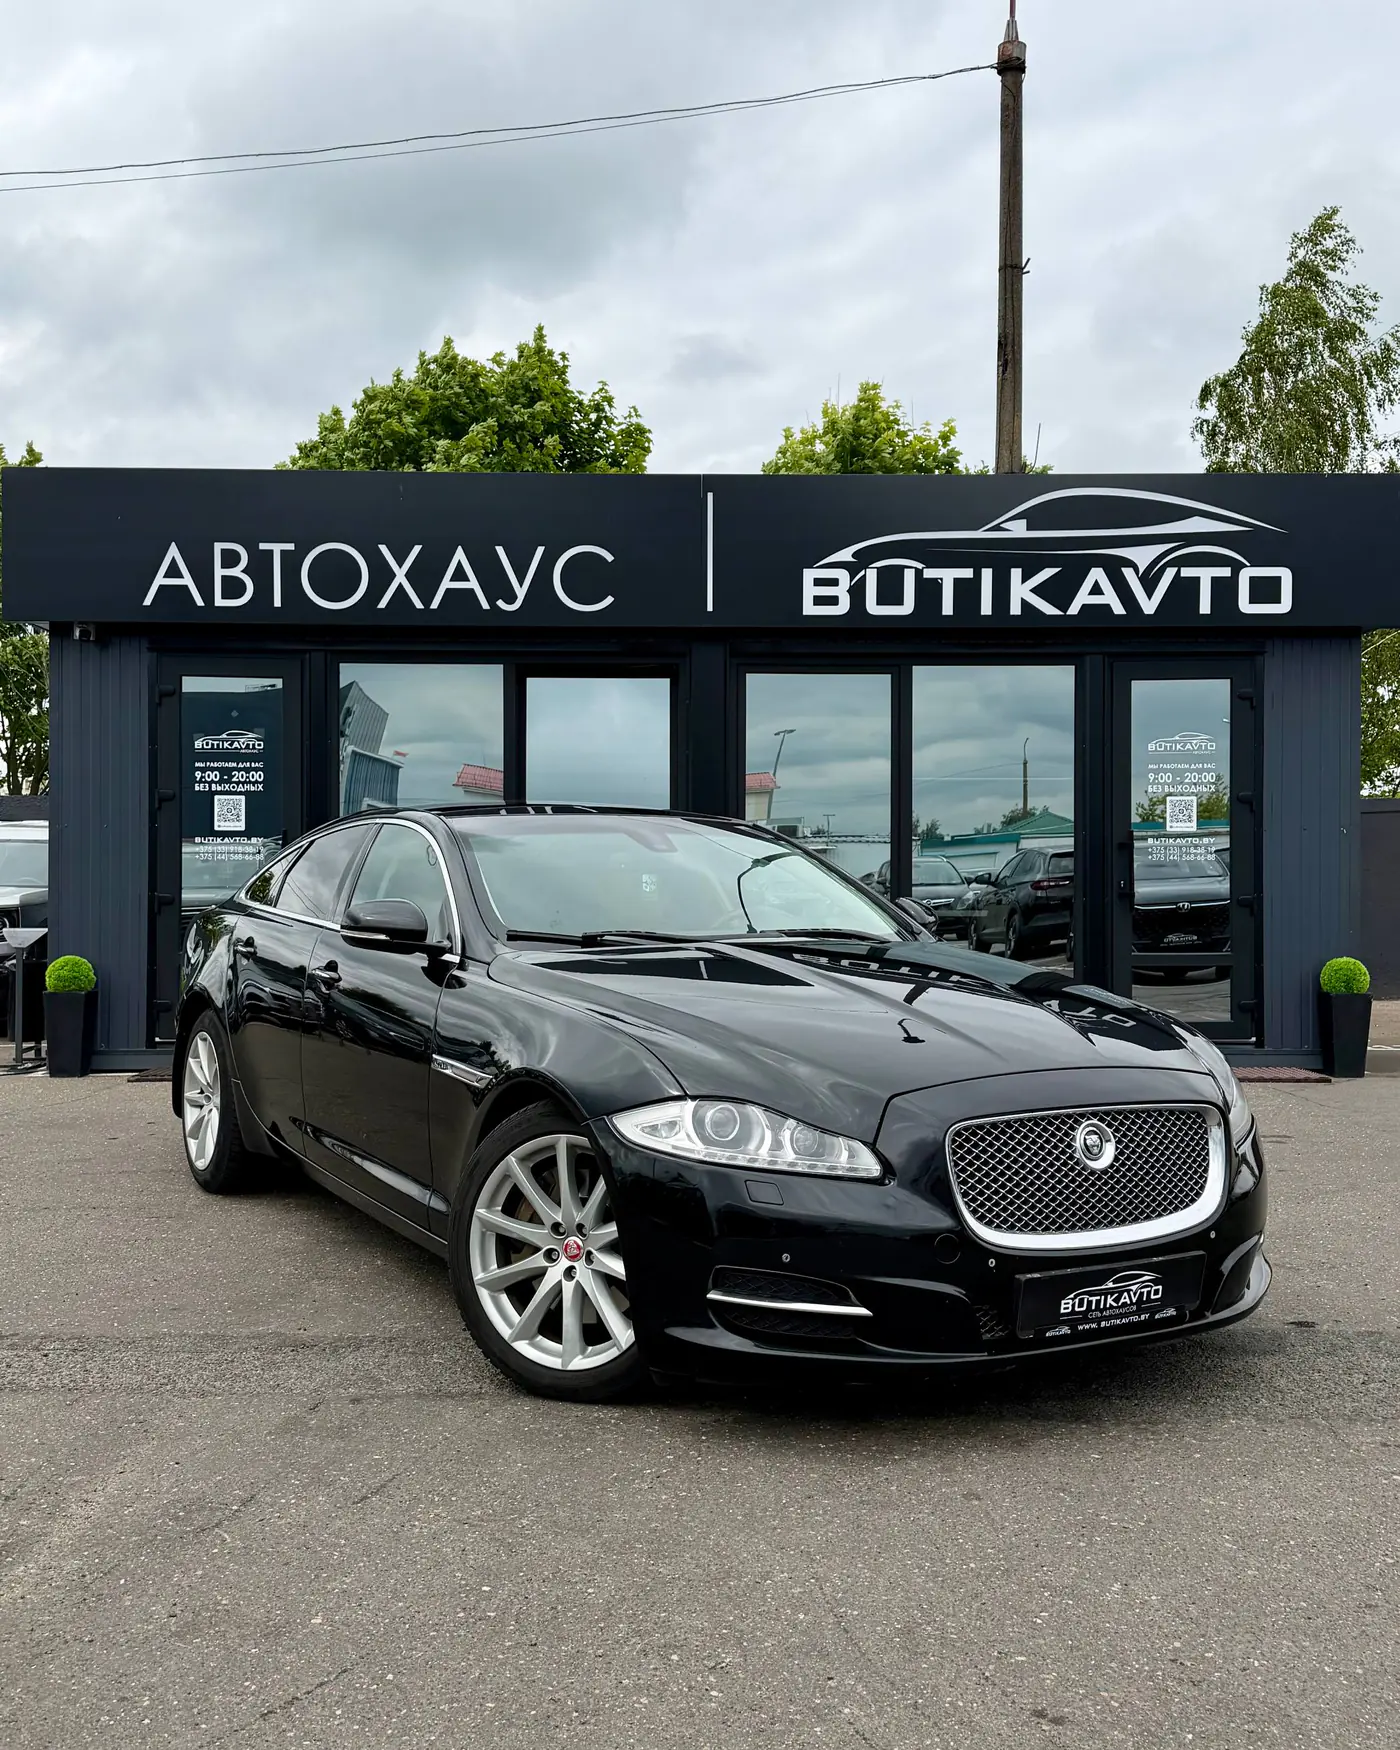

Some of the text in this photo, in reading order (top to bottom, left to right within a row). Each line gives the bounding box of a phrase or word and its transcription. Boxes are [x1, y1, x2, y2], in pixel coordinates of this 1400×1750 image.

[143, 541, 616, 612] АВТОХАУС
[802, 565, 1293, 616] BUTIKAVTO
[194, 740, 264, 749] BUTIKAVTO
[1148, 742, 1216, 750] BUTIKAVTO
[195, 771, 220, 782] 9:00
[231, 771, 264, 782] 20:00
[1148, 772, 1172, 783] 9:00
[1184, 772, 1216, 783] 20:00
[194, 783, 264, 792] БЕЗ ВЫХОДНЫХ
[1164, 785, 1216, 793] ВЫХОДНЫХ
[1060, 1285, 1163, 1314] BUTIKAVTO
[1102, 1305, 1137, 1316] АВТОХАУСОВ
[1100, 1313, 1150, 1328] BUTIKAVTO.BY
